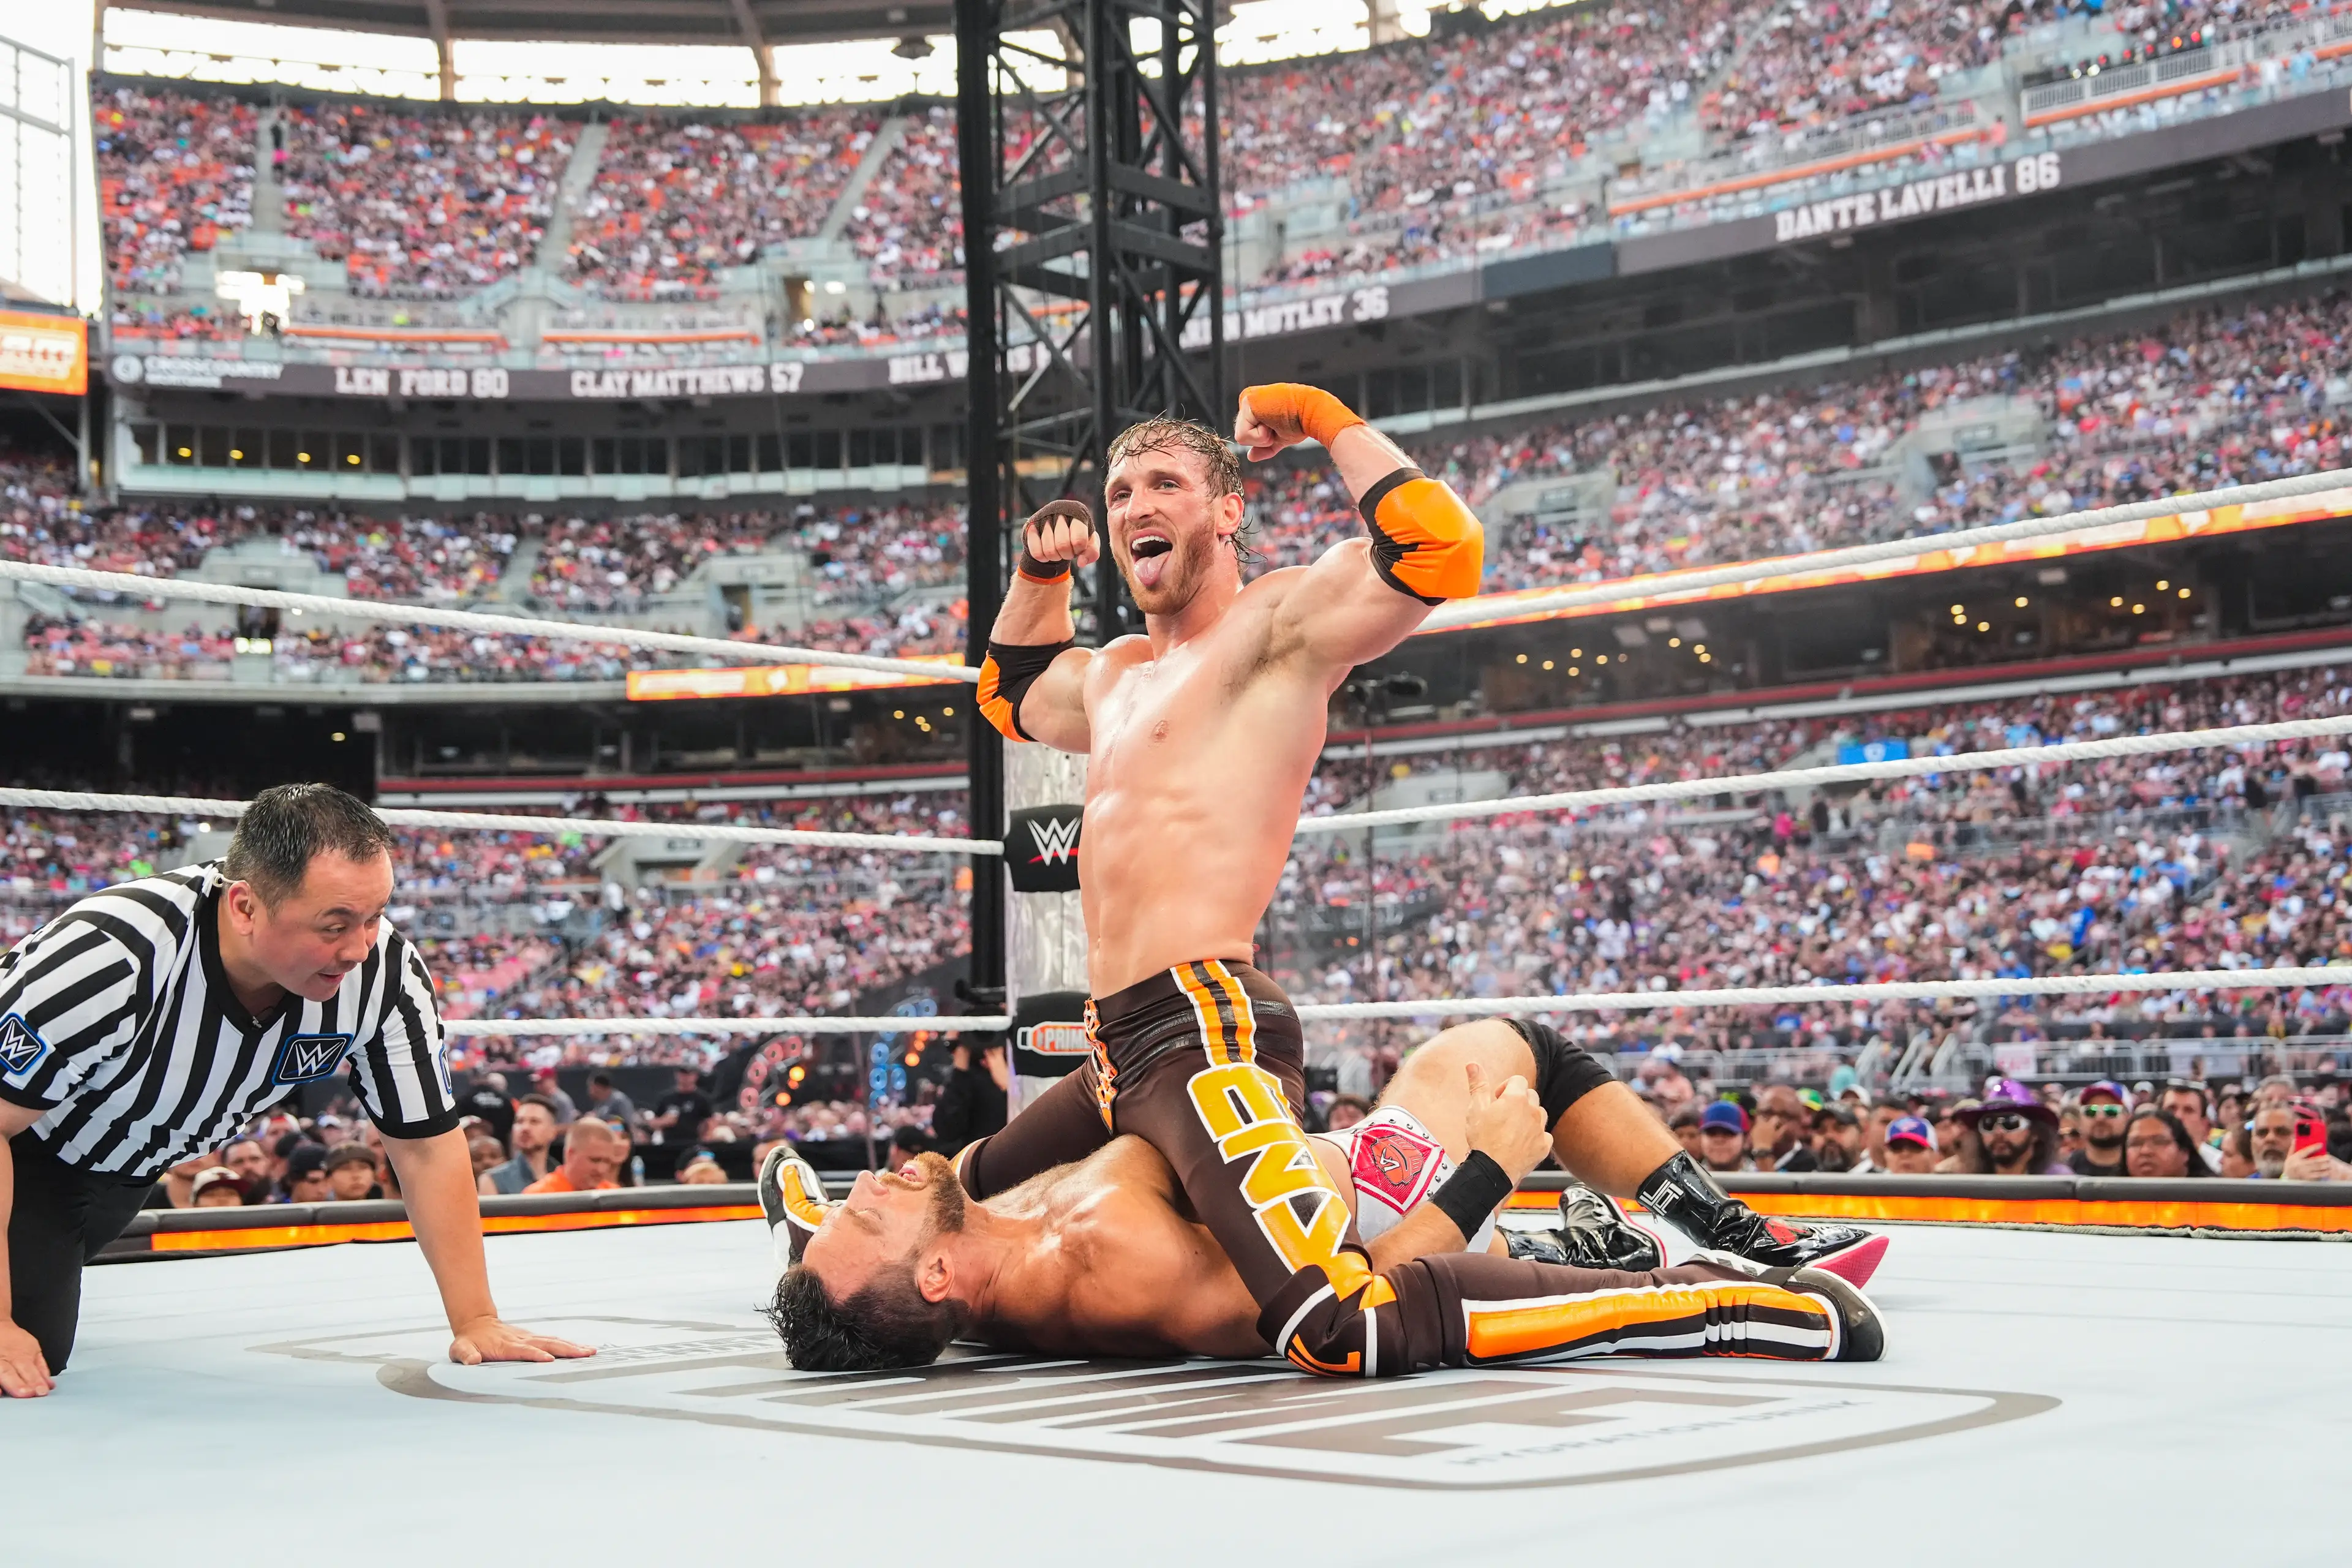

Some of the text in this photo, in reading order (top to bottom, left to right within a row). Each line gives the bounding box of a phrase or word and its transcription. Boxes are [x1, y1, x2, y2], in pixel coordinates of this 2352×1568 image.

[1776, 151, 2060, 242] DANTE LAVELLI 86
[1353, 286, 1389, 322] 36
[335, 367, 509, 398] LEN FORD 80
[571, 361, 804, 398] CLAY MATTHEWS 57
[889, 354, 944, 384] BILL
[1447, 1400, 1872, 1465] HYDRATION DRINK
